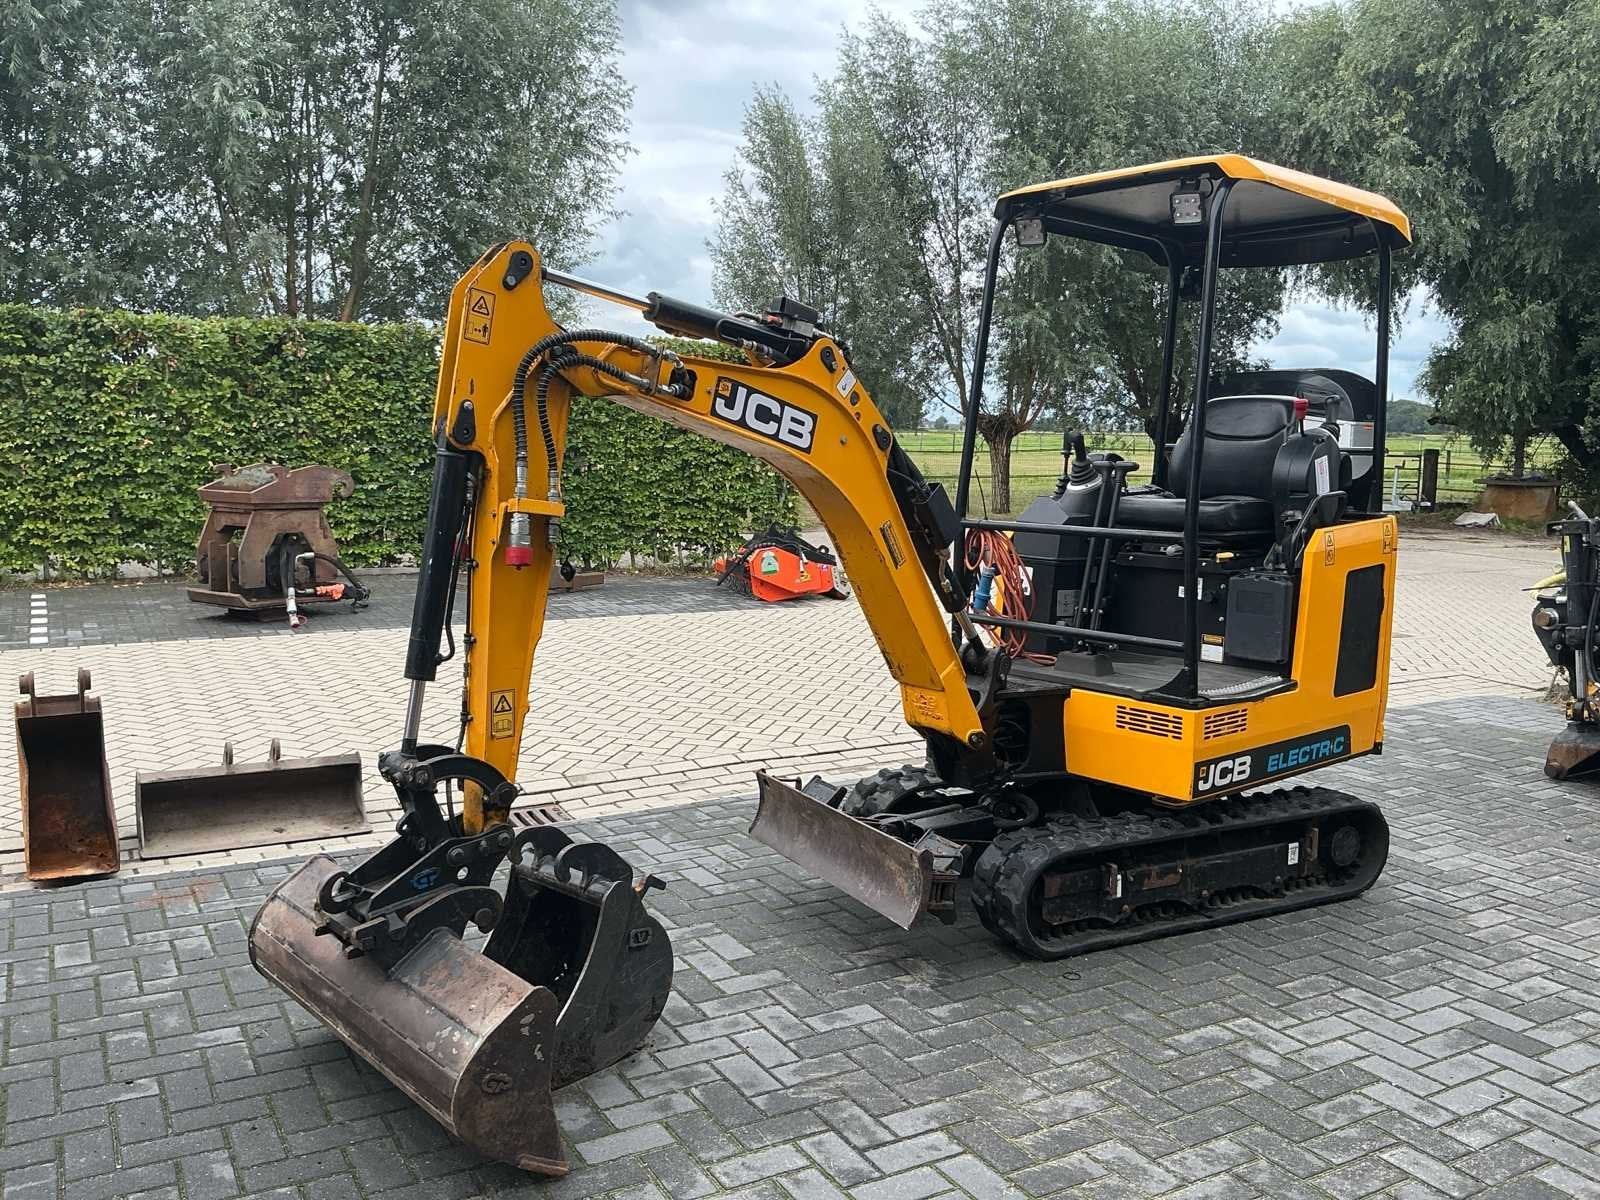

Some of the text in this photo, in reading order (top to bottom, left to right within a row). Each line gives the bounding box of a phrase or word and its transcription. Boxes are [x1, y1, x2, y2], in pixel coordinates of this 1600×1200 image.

[715, 386, 813, 448] JCB
[1198, 736, 1344, 790] JCB ELECTRIC
